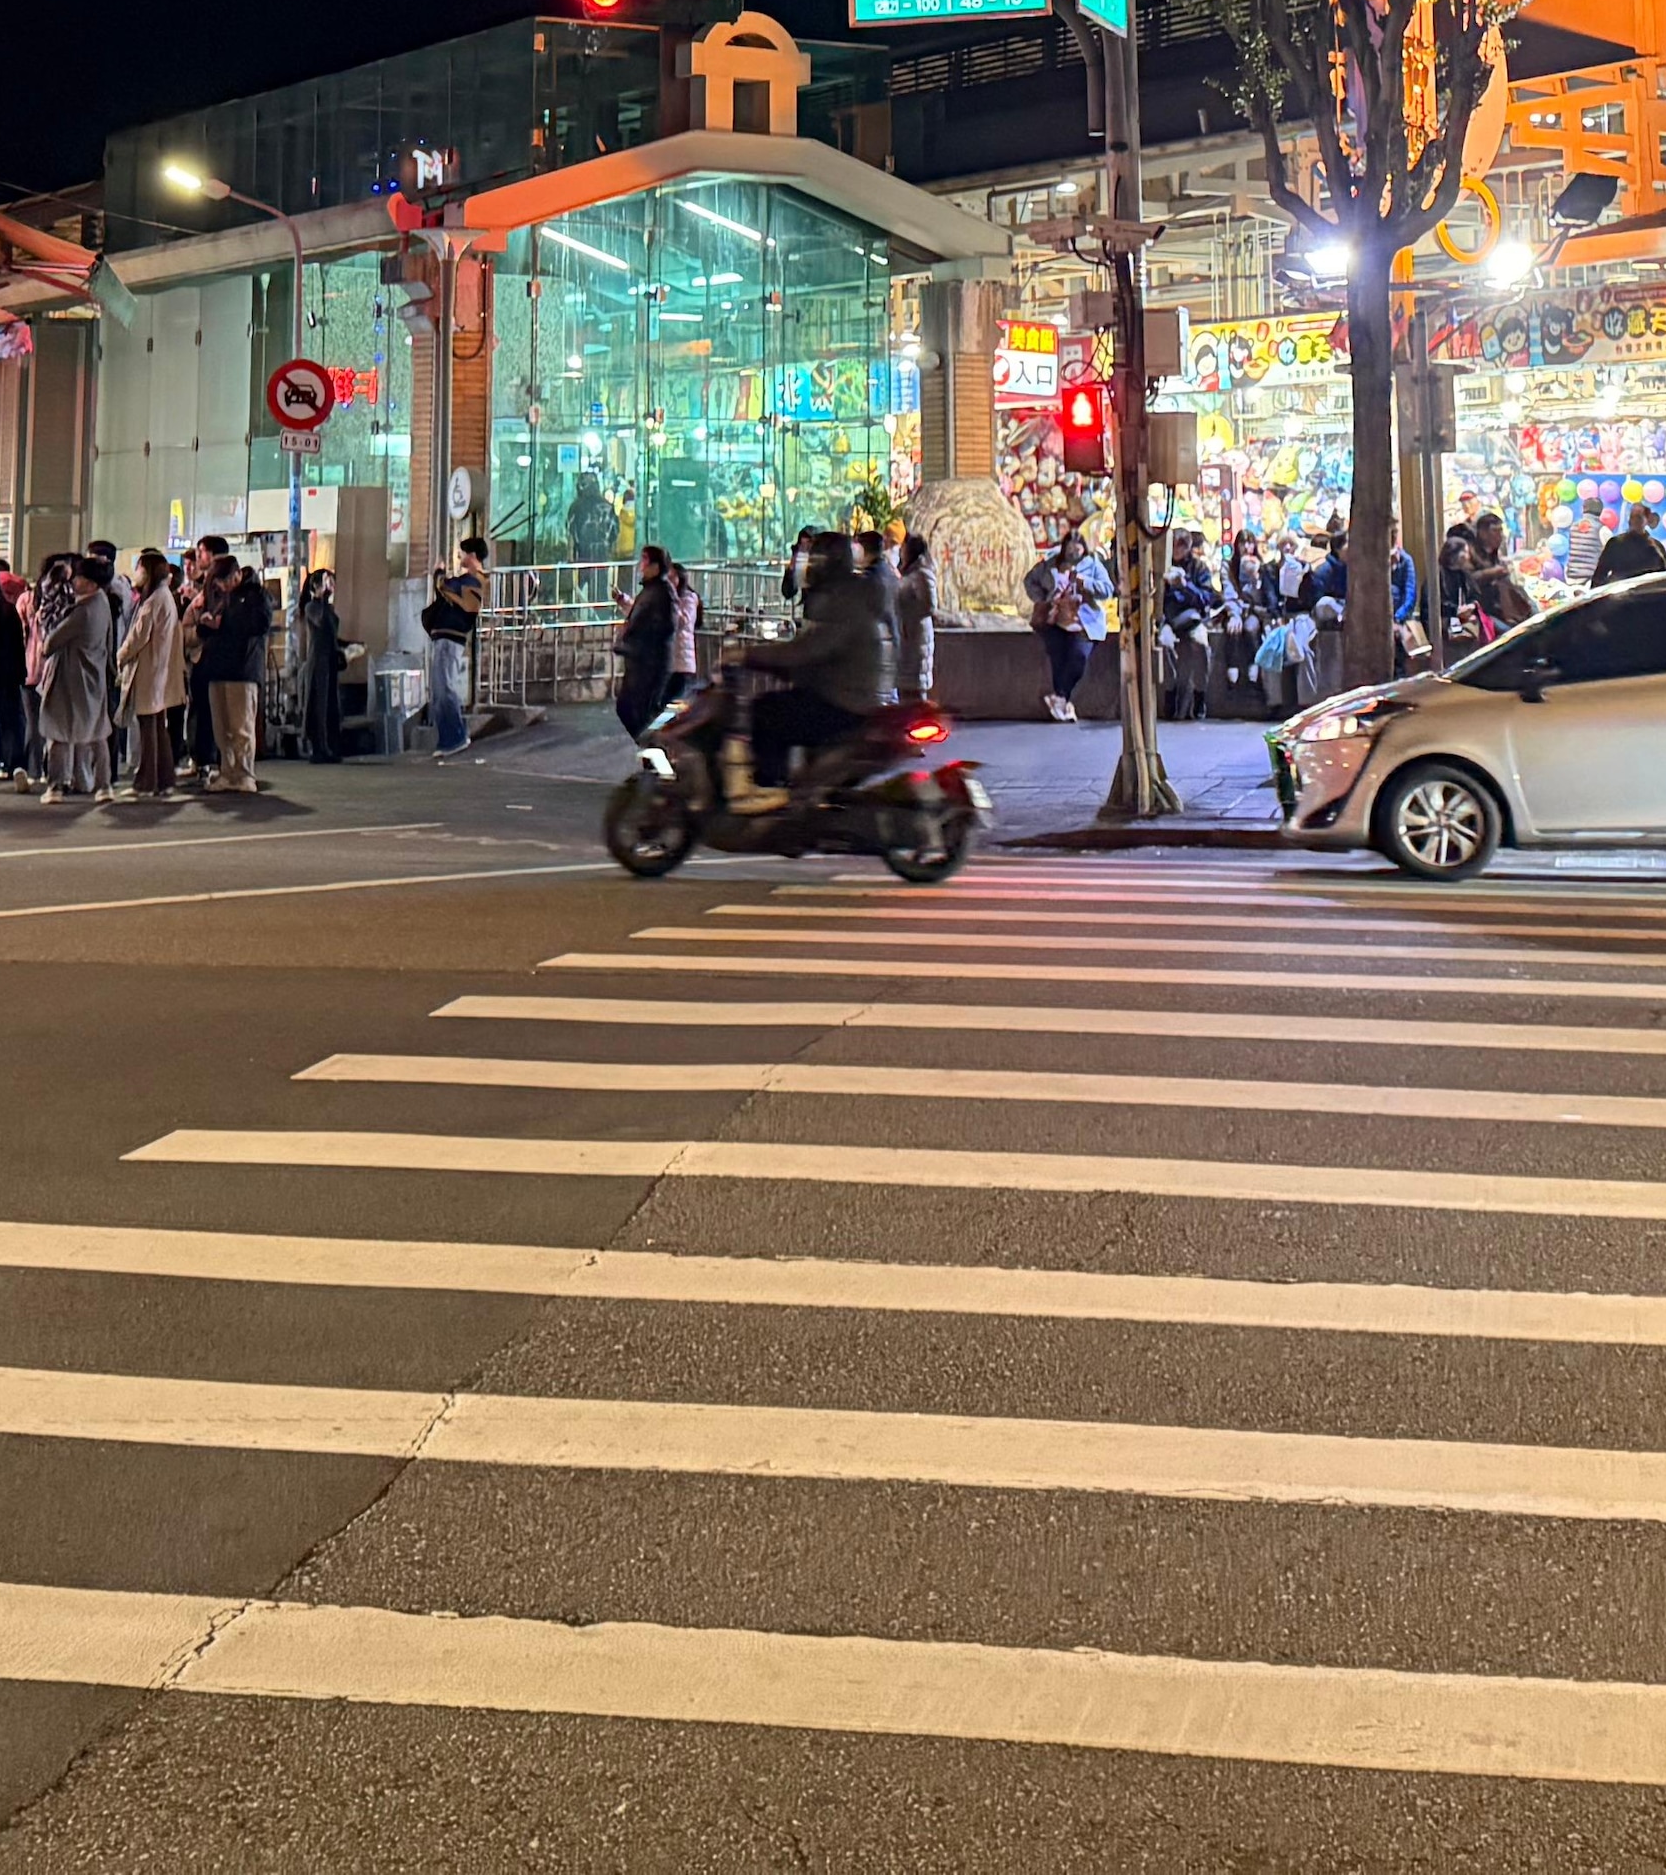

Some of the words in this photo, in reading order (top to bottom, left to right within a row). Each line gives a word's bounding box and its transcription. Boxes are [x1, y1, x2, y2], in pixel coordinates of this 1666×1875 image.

[1010, 326, 1055, 353] 美食區
[1015, 360, 1053, 385] 入口
